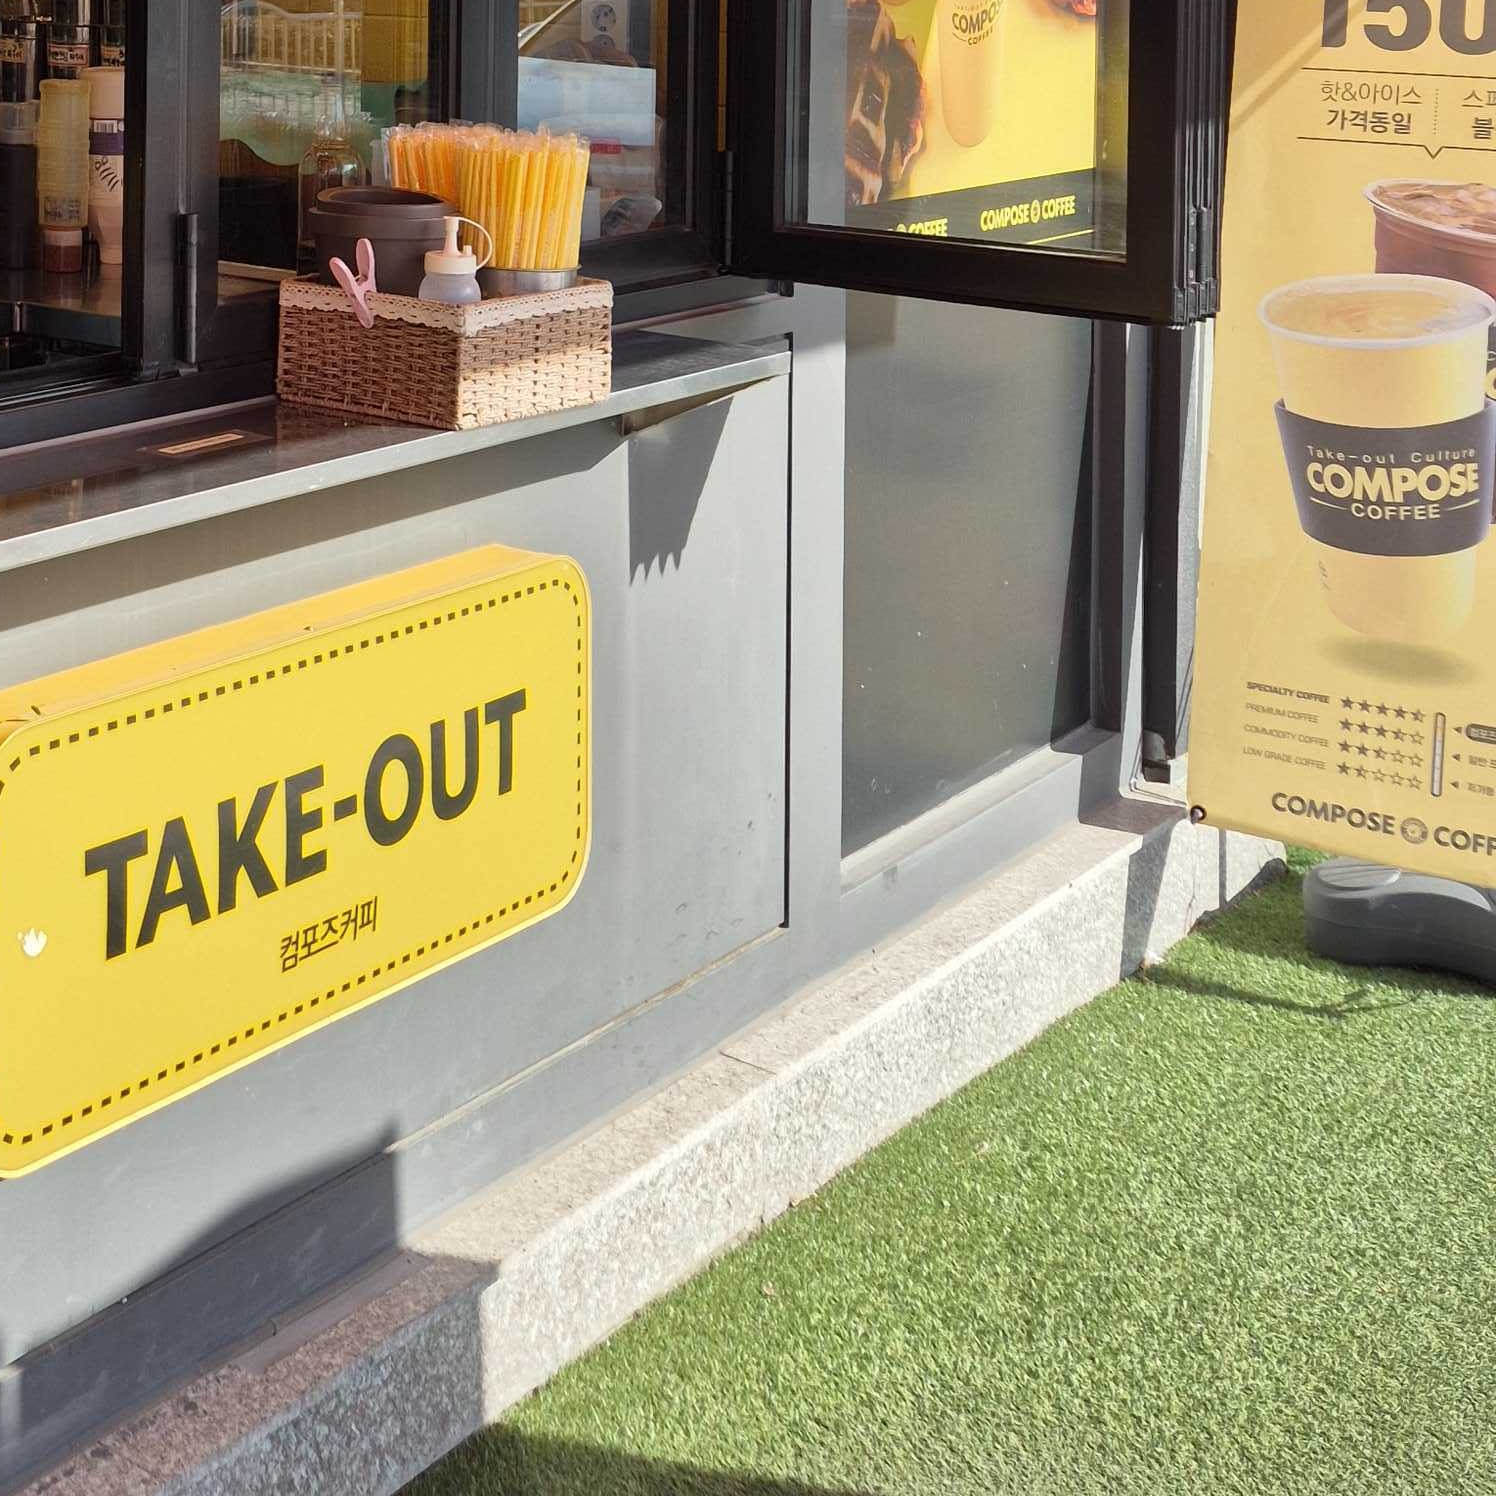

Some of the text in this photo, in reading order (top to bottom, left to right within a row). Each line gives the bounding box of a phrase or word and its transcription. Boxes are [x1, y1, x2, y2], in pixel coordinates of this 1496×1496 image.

[1320, 80, 1423, 105] 핫&아이스
[1326, 108, 1413, 135] 가격동일
[980, 195, 1076, 232] COMPOSE COFFEE
[1307, 444, 1476, 464] Take-out Culture
[1307, 462, 1479, 503] COMPOSE
[1351, 502, 1441, 521] COFFEE
[1246, 681, 1330, 704] SPECIALTY COFFEE
[1287, 711, 1320, 724] COFFEE
[1298, 734, 1330, 747] COFFEE
[1242, 746, 1328, 770] LOW GRADE COFFEE
[85, 689, 526, 960] TAKE-OUT
[1271, 791, 1396, 836] COMPOSE
[279, 897, 378, 973] 컴포즈커피
